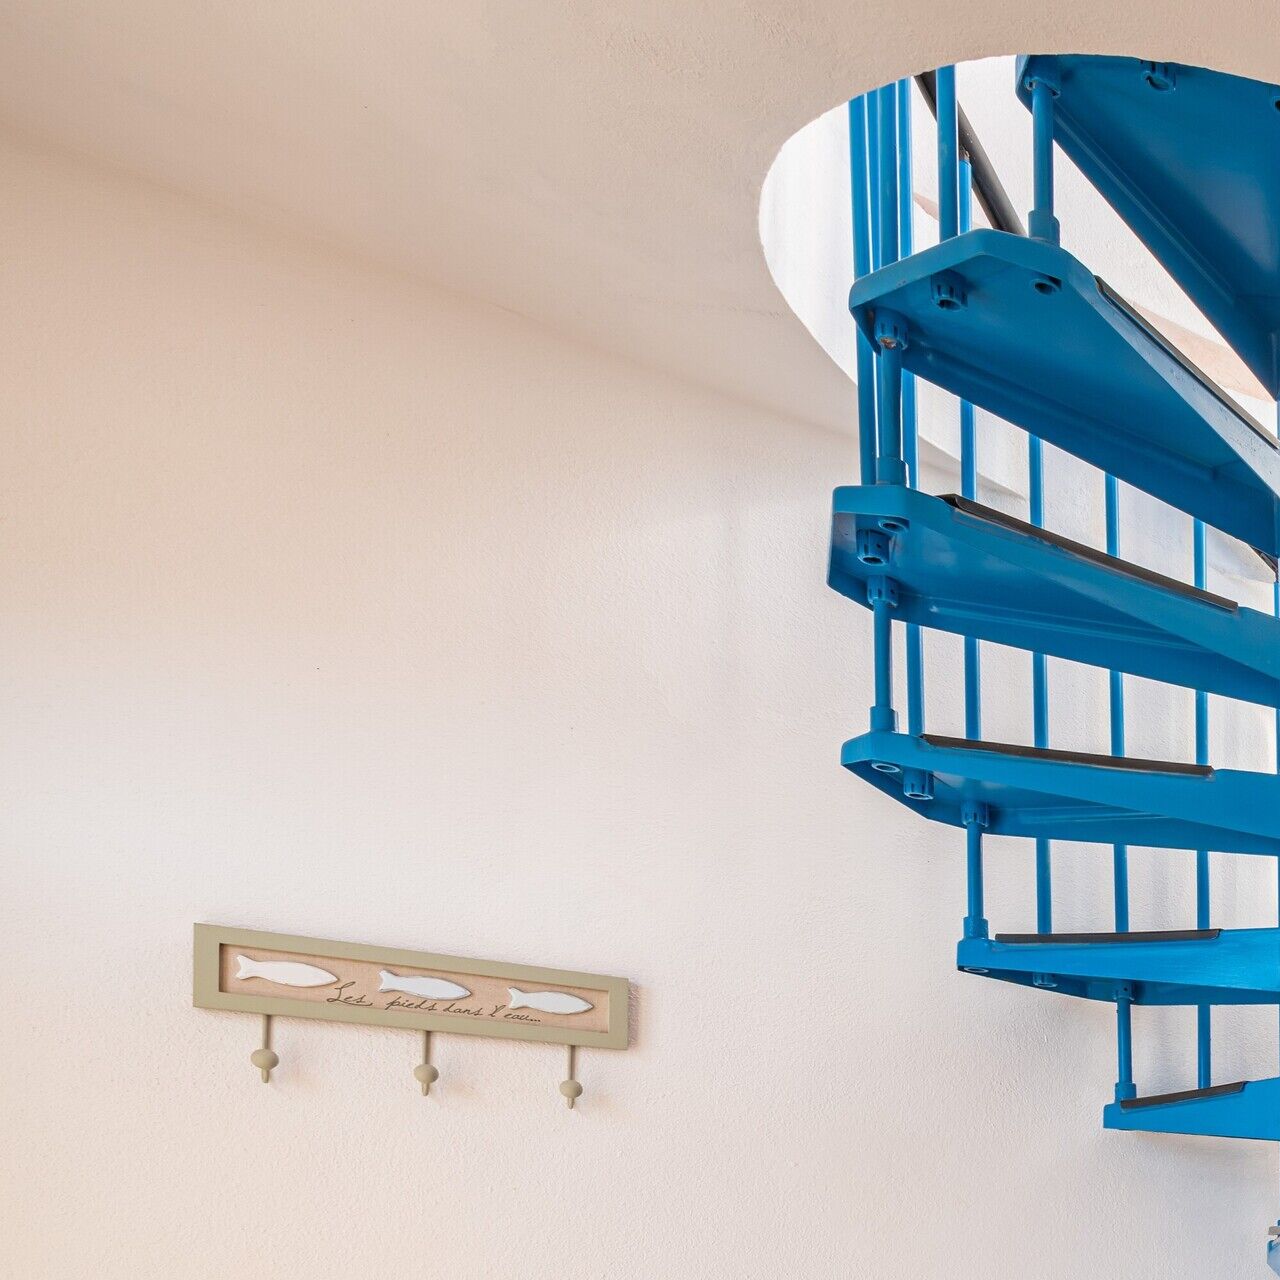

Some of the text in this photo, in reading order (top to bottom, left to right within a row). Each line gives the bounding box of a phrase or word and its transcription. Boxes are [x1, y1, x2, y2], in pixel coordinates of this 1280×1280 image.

[326, 981, 373, 1007] Les
[385, 996, 438, 1011] pieds
[443, 1003, 483, 1016] dans
